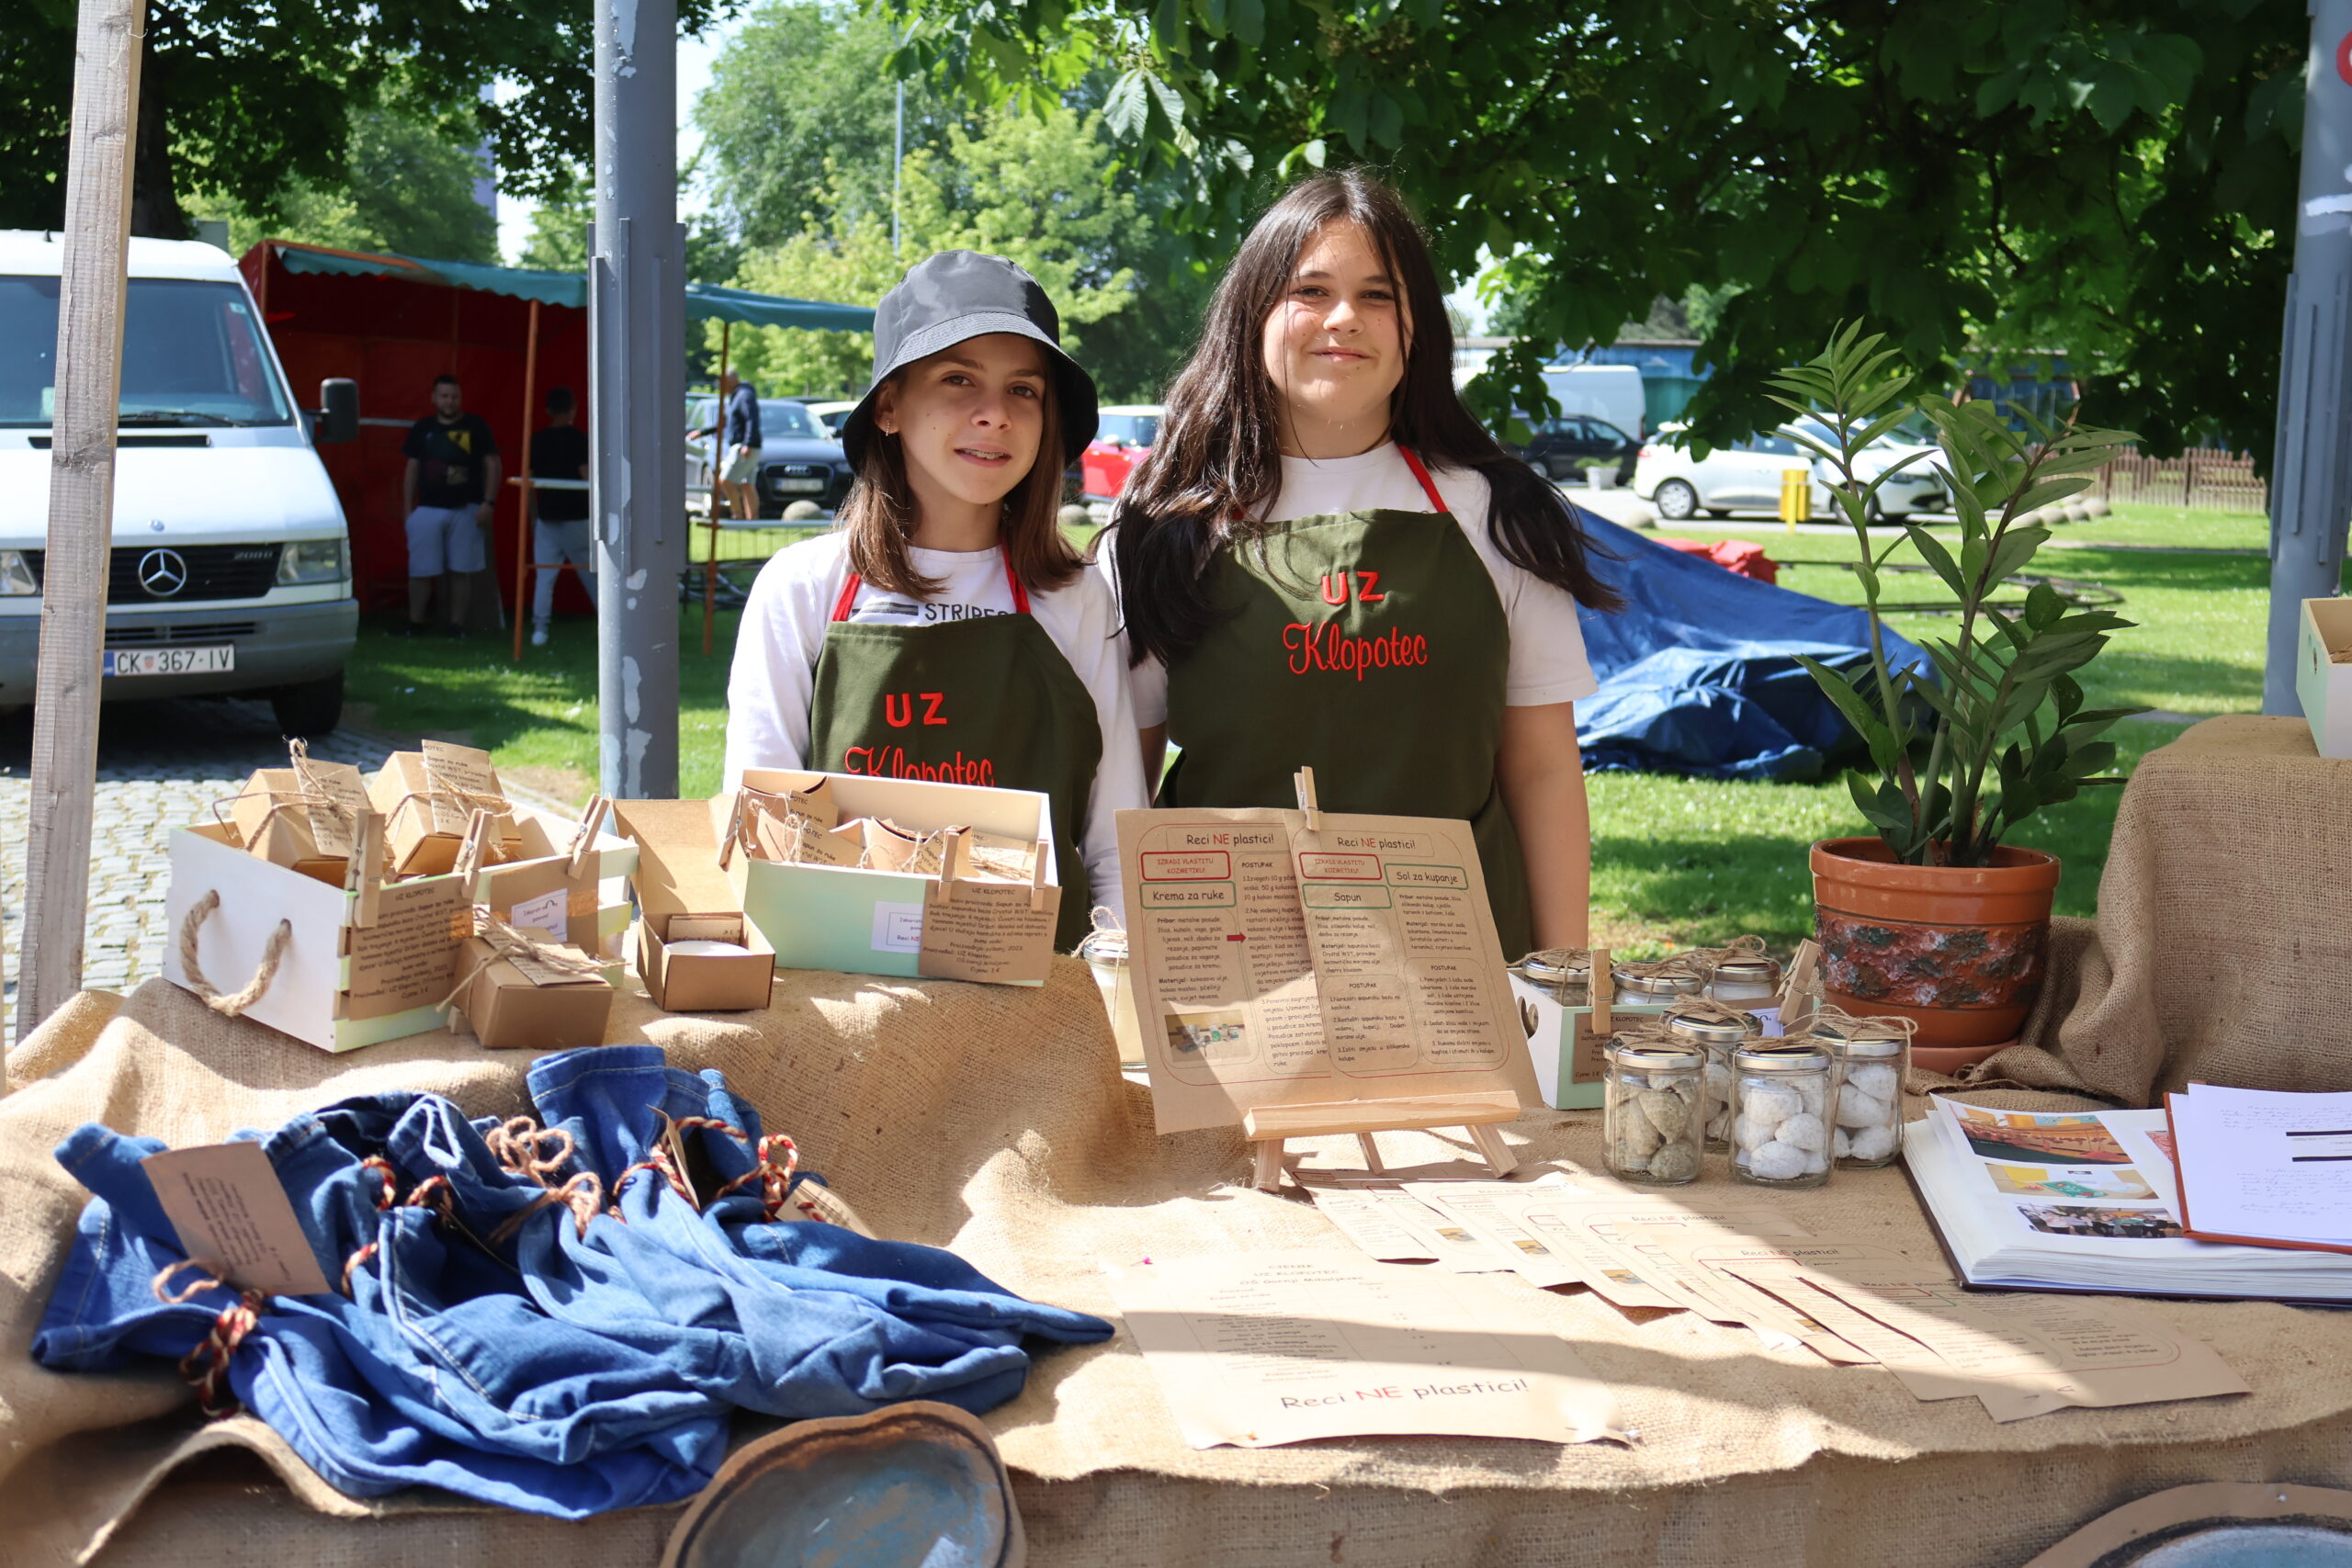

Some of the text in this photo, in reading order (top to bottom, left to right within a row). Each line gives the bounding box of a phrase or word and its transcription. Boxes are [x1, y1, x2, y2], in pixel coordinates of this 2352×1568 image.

[1321, 571, 1385, 605] UZ
[1283, 621, 1428, 682] Klopotec
[118, 653, 141, 673] CK
[886, 692, 947, 728] UZ
[1186, 833, 1274, 847] Reci NE plastici!
[1338, 837, 1416, 850] Reci NE plastici!
[1396, 872, 1410, 880] Sol
[1425, 872, 1458, 885] kupanje
[1153, 891, 1184, 901] Krema
[1202, 890, 1225, 900] ruke
[1334, 893, 1362, 903] Sapun
[1281, 1378, 1530, 1409] Reci NE plastici!
